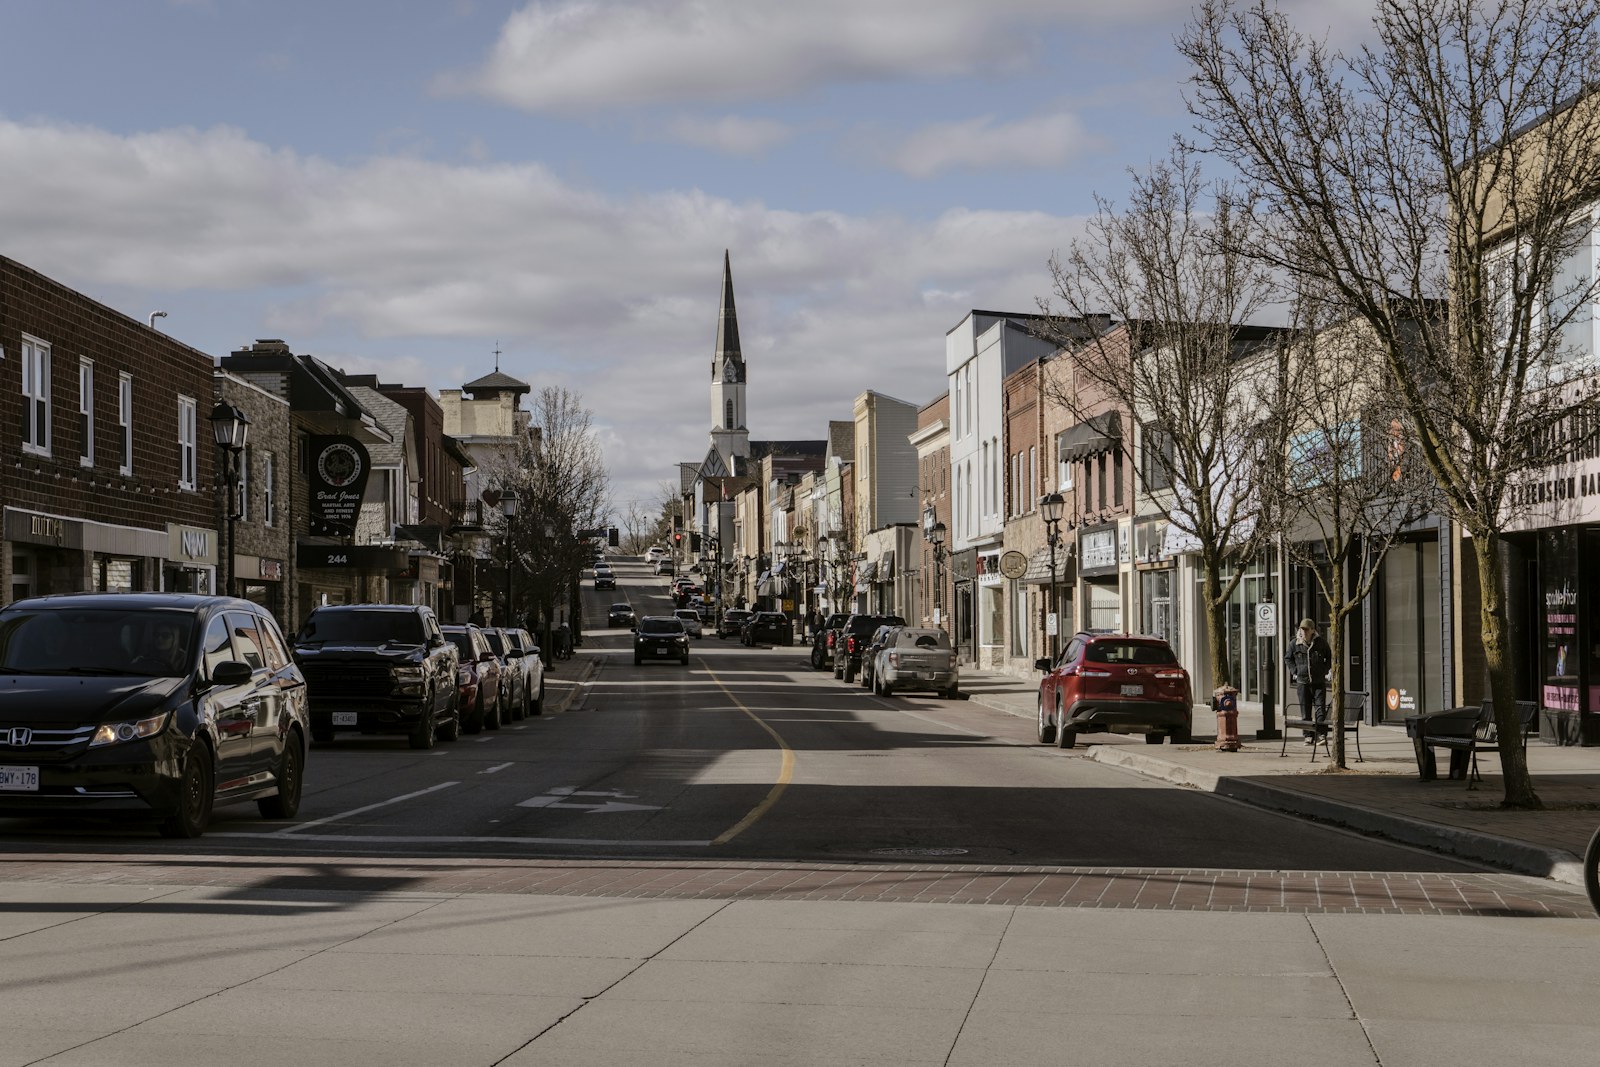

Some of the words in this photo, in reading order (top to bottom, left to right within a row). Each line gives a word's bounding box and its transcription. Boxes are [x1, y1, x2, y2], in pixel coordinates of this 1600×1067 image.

[317, 491, 338, 500] Brad
[339, 491, 360, 502] Jones
[327, 554, 347, 563] 244
[21, 772, 37, 785] 178
